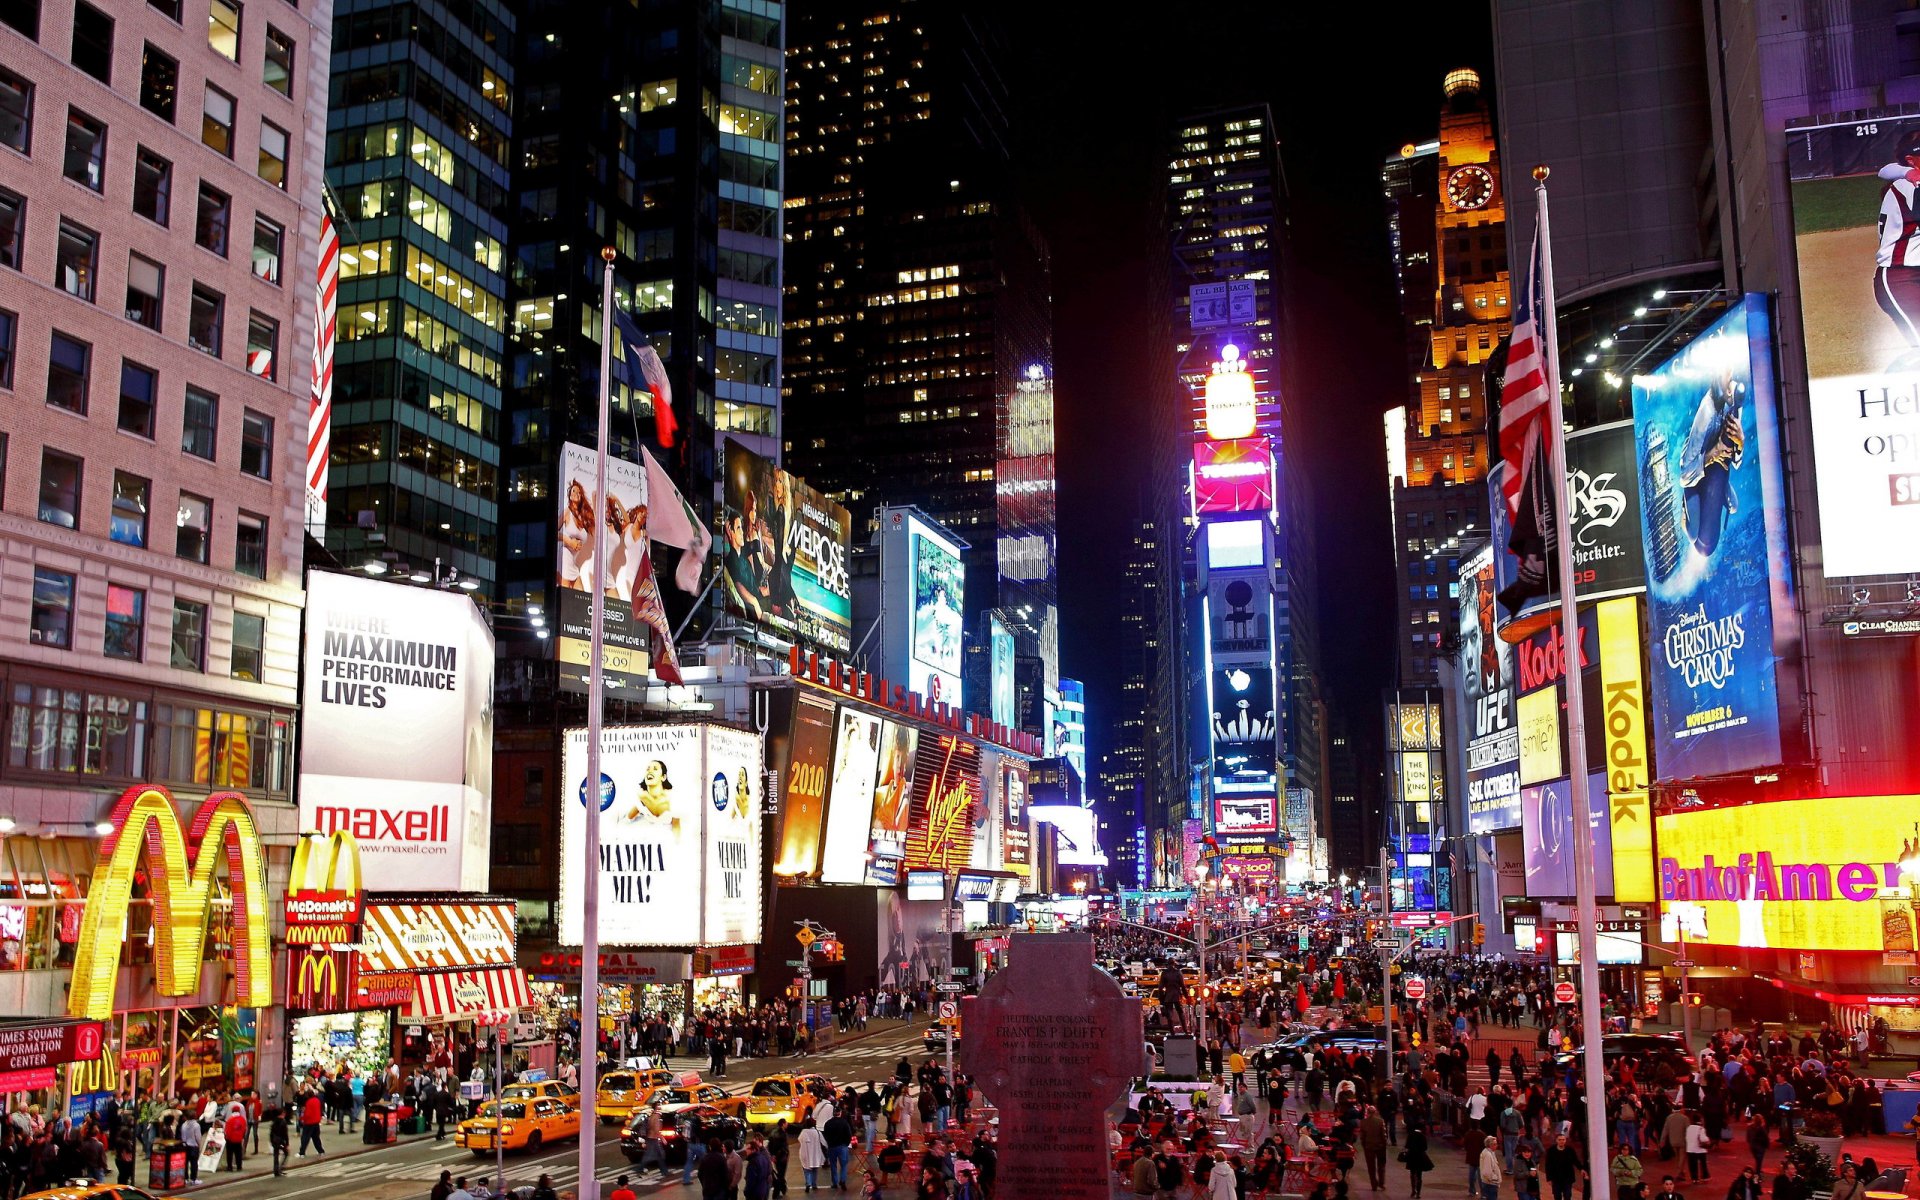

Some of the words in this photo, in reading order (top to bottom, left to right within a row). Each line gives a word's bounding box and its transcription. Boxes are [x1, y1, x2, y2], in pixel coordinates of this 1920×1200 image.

[1856, 124, 1878, 136] 215
[1195, 287, 1211, 296] I'LL
[1857, 383, 1920, 418] Hel
[787, 520, 844, 574] MELROSE
[817, 562, 849, 600] PLACE
[326, 609, 390, 635] WHERE
[1698, 603, 1708, 625] A
[567, 626, 584, 635] WANT
[584, 627, 593, 637] TO
[610, 633, 625, 643] WHAT
[625, 635, 640, 646] LOVE
[1214, 639, 1268, 651] CHEVROLET
[1663, 613, 1745, 669] CHRISTMAS
[323, 630, 457, 671] MAXIMUM
[322, 659, 455, 691] PERFORMANCE
[1681, 648, 1735, 689] CAROL
[321, 680, 387, 709] LIVES
[1476, 688, 1508, 737] UFC
[1686, 707, 1726, 728] NOVEMBER
[1726, 705, 1733, 719] 6
[1523, 724, 1554, 757] smile?
[1606, 680, 1645, 824] Kodak
[1408, 761, 1423, 769] THE
[789, 761, 825, 798] 2010
[1407, 770, 1426, 781] LION
[769, 770, 778, 804] COMING
[1407, 783, 1427, 795] KING
[1484, 772, 1513, 799] OCTOBER
[769, 805, 778, 815] IS
[315, 804, 449, 843] maxell
[598, 844, 665, 872] MAMMA
[718, 841, 748, 870] MAMMA
[724, 871, 742, 899] MIA!
[1661, 855, 1721, 902] Bank
[1754, 851, 1905, 902] Amer
[612, 875, 651, 904] MIA!
[286, 899, 356, 913] McDonald's
[297, 913, 344, 921] Restaurant
[1556, 922, 1641, 931] MAQUIS
[541, 952, 638, 967] DIGTAL
[600, 967, 656, 976] OMPUTERS
[1002, 1015, 1053, 1024] LIEUTENANT
[1056, 1015, 1097, 1024] COLONEL
[0, 1030, 25, 1044] IMES
[27, 1027, 64, 1041] SQUARE
[996, 1027, 1047, 1038] FRANCIS
[1063, 1027, 1106, 1038] DUFFY
[0, 1040, 61, 1057] NFORMATION
[1002, 1041, 1018, 1049] MAY
[10, 1054, 47, 1068] CENTER
[1010, 1056, 1054, 1065] CATHOLIC
[1058, 1056, 1092, 1065] PRIEST
[1021, 1125, 1040, 1134] LIFE
[1058, 1125, 1093, 1135] SERVICE
[1008, 1142, 1029, 1152] GOD
[1031, 1142, 1051, 1152] AND
[1053, 1142, 1096, 1152] COUNTRY
[1080, 1166, 1098, 1174] WAR
[1039, 1177, 1078, 1185] NATIONAL
[1080, 1178, 1108, 1186] GUARD
